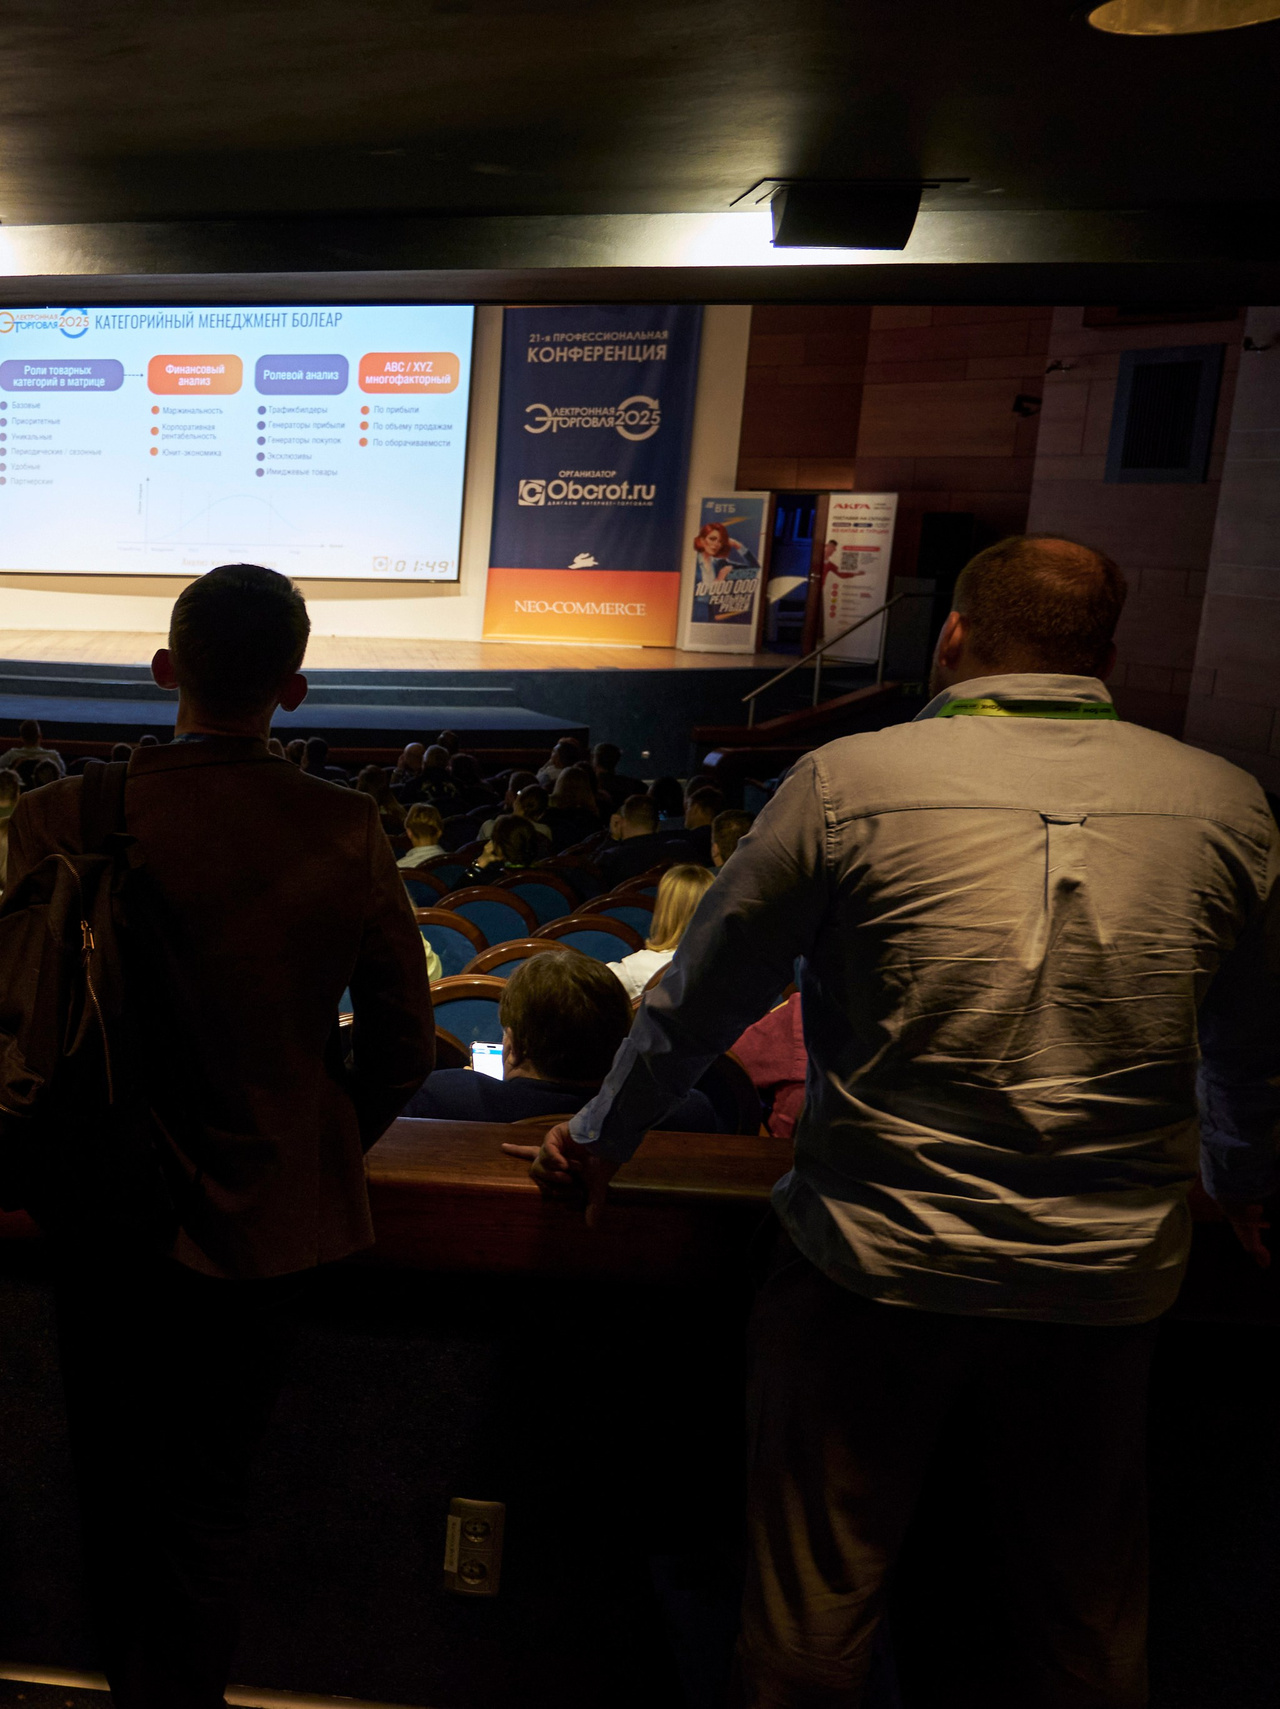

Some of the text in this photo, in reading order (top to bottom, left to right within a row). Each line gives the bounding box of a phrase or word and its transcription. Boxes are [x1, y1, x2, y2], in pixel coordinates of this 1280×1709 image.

[58, 316, 89, 327] 2025
[95, 312, 343, 330] КАТЕГОРИЙНЫЙ МЕНЕДЖМЕНТ БОЛЕАР
[529, 330, 668, 342] 21-я ПРОФЕССИОНАЛЬНАЯ
[527, 344, 667, 363] КОНФЕРЕНЦИЯ
[24, 365, 91, 376] Роли товарных
[165, 363, 225, 374] Финансовый
[384, 362, 405, 373] ABC
[413, 362, 433, 372] XYZ
[263, 369, 339, 380] Ролевой анализ
[365, 374, 451, 385] многофакторный
[13, 377, 58, 388] категорий
[67, 379, 105, 388] матрице
[178, 377, 211, 386] анализ
[11, 401, 41, 409] Базовые
[268, 405, 328, 415] Трафикбилдеры
[162, 406, 223, 415] Маржинальность
[386, 406, 419, 415] прибыли
[11, 417, 61, 425] Приоритетные
[615, 410, 661, 425] 2025
[162, 423, 215, 432] Корпоративная
[268, 421, 345, 430] Генераторы прибыли
[373, 422, 383, 430] По
[414, 423, 453, 431] продажам
[161, 433, 217, 441] рентабельность
[267, 436, 341, 445] Генераторы покупок
[385, 439, 451, 447] оборачиваемости
[266, 468, 338, 477] Имиджевые товары
[558, 470, 617, 478] ОРГАНИЗАТОР
[715, 503, 736, 513] ВТБ
[514, 600, 647, 616] NEO-COMMERCE
